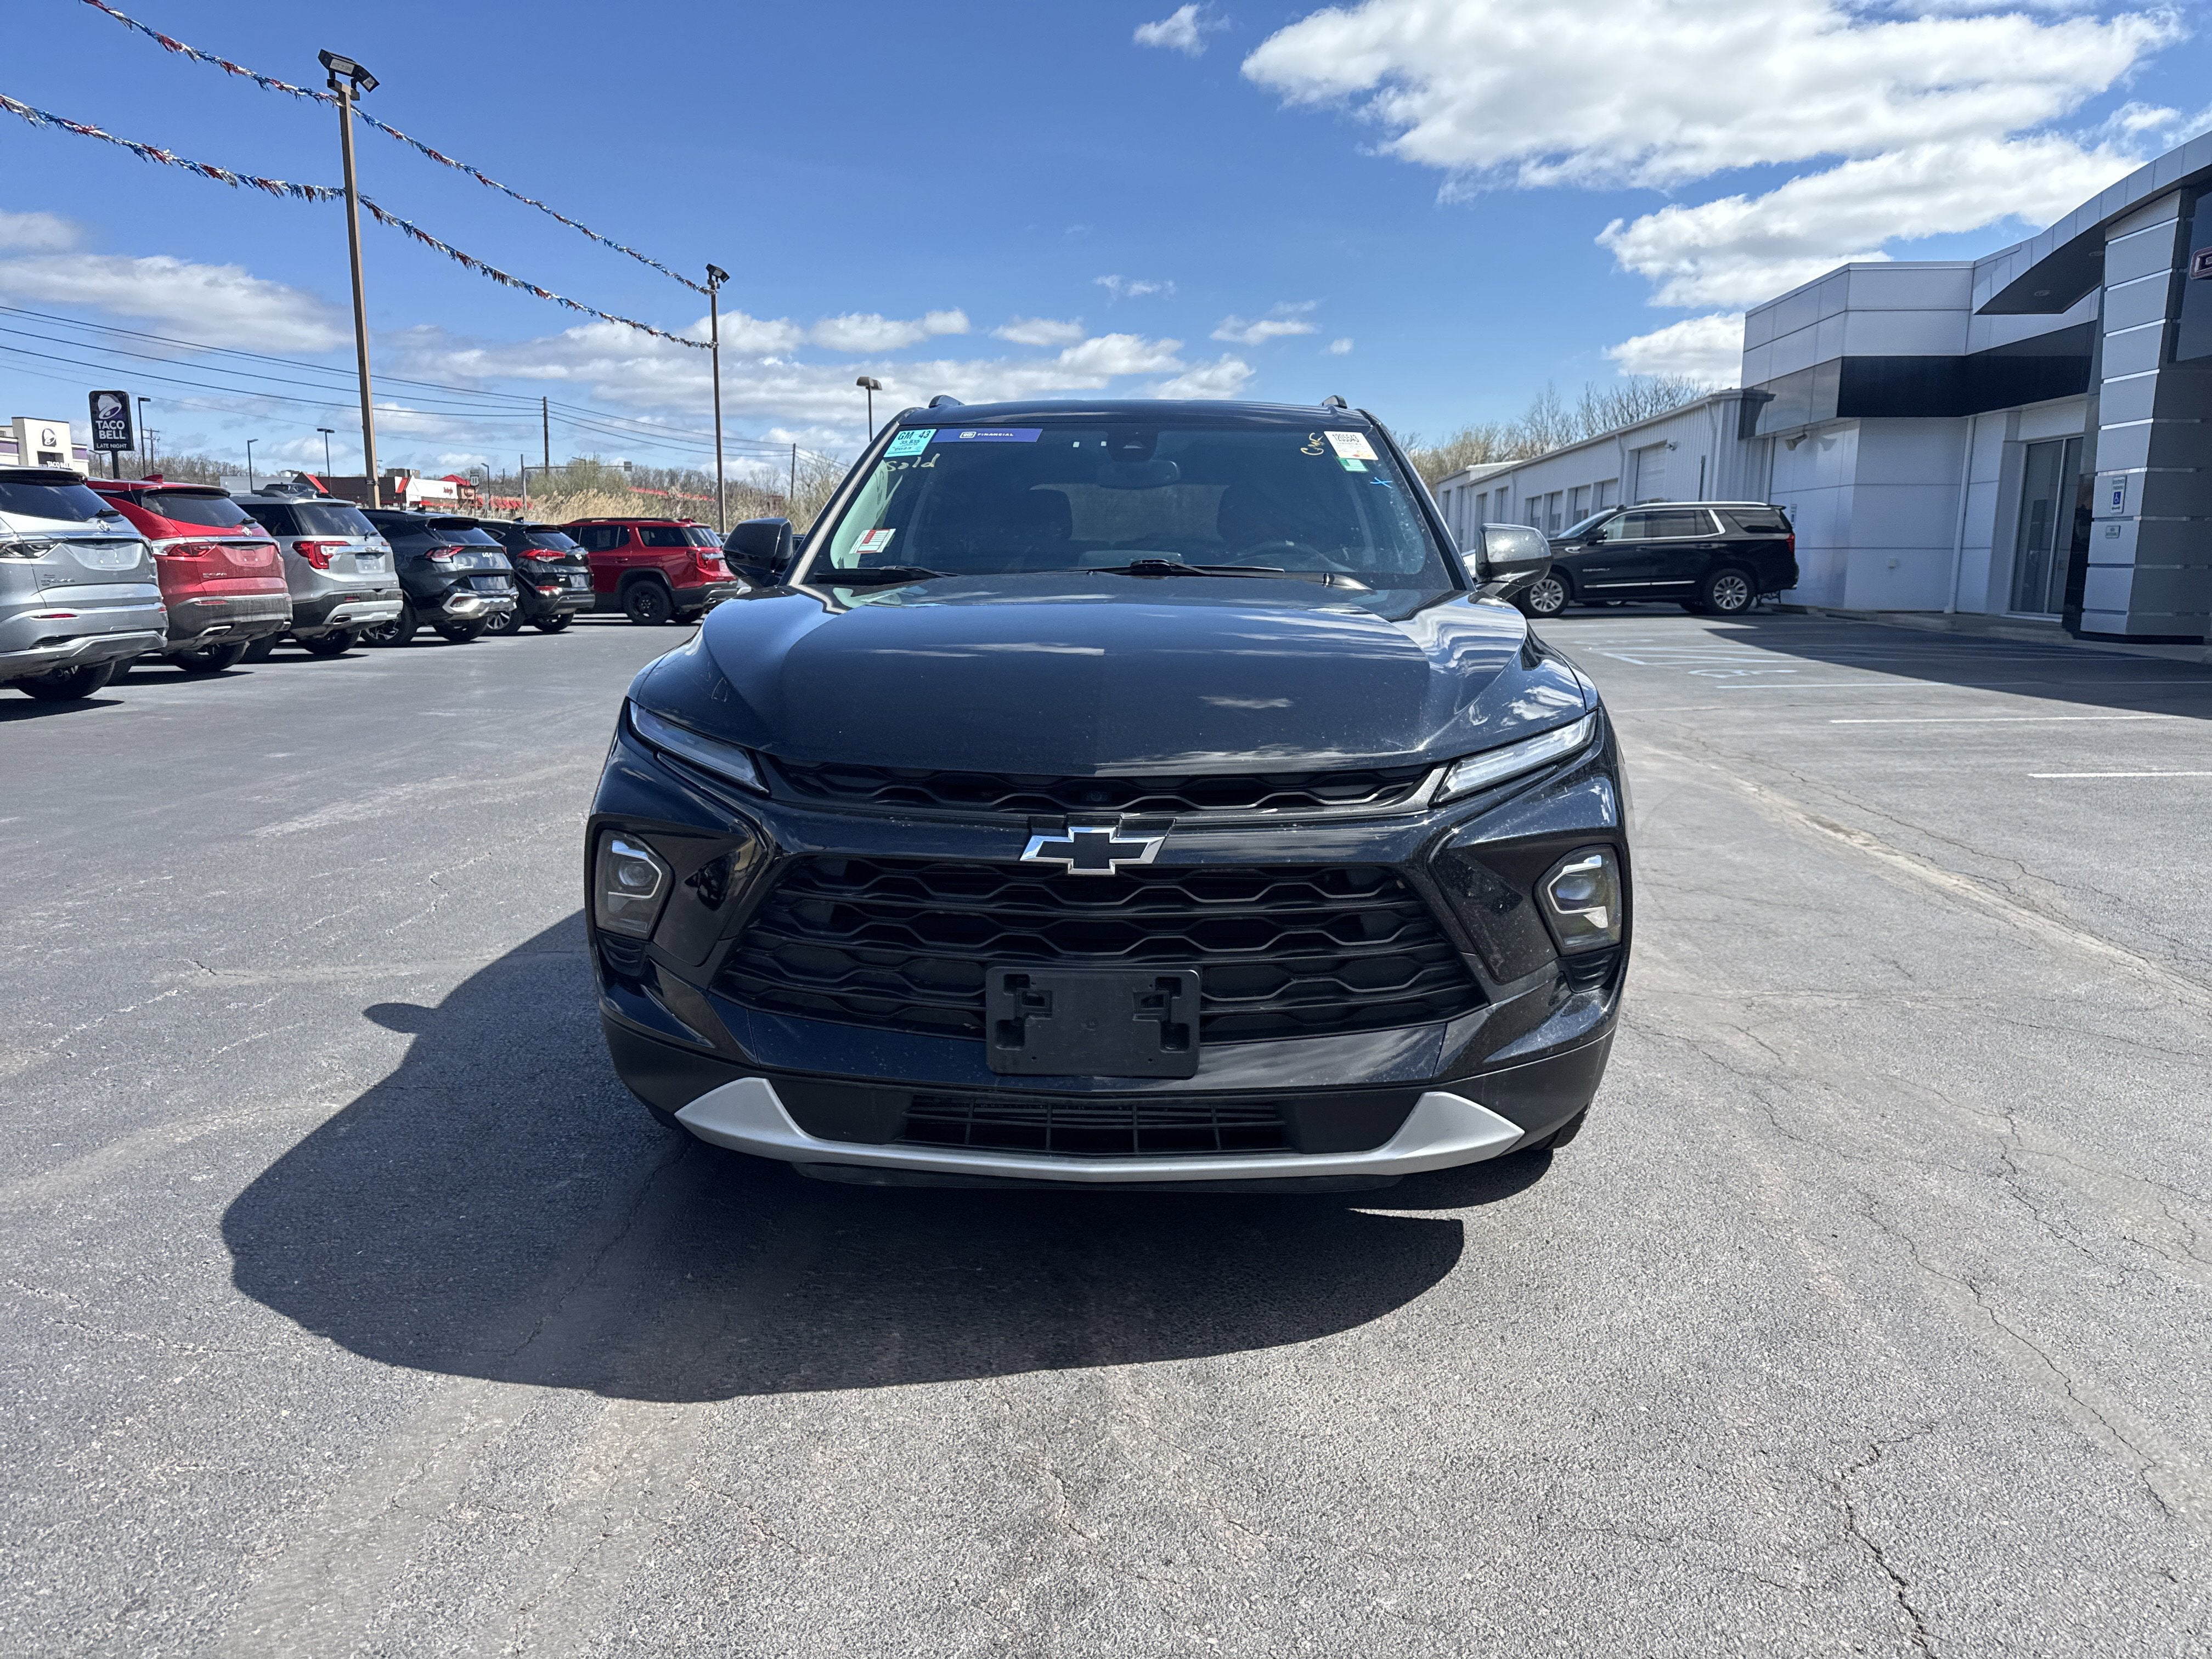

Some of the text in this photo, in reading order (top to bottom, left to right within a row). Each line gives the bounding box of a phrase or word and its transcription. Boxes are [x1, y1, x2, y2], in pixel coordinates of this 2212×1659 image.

[95, 420, 125, 430] TACO
[99, 430, 126, 439] BELL
[898, 430, 931, 440] GM 43
